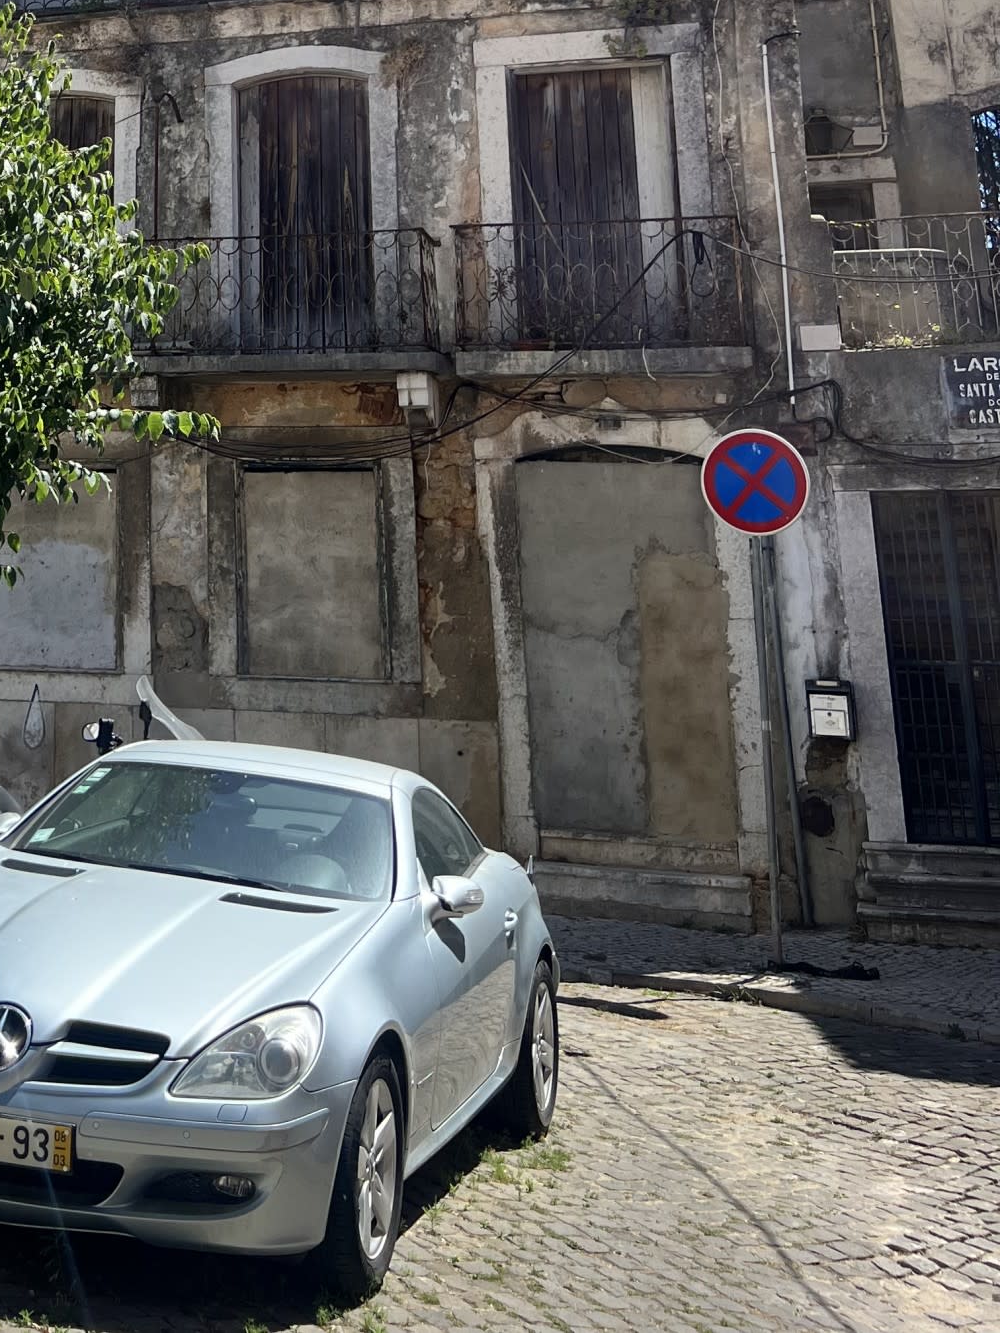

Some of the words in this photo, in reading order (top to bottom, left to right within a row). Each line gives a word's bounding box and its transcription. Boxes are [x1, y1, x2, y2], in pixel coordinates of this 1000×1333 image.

[953, 357, 1000, 372] LAR
[986, 373, 999, 381] DE
[959, 383, 995, 397] SANTA
[53, 1154, 66, 1166] 03
